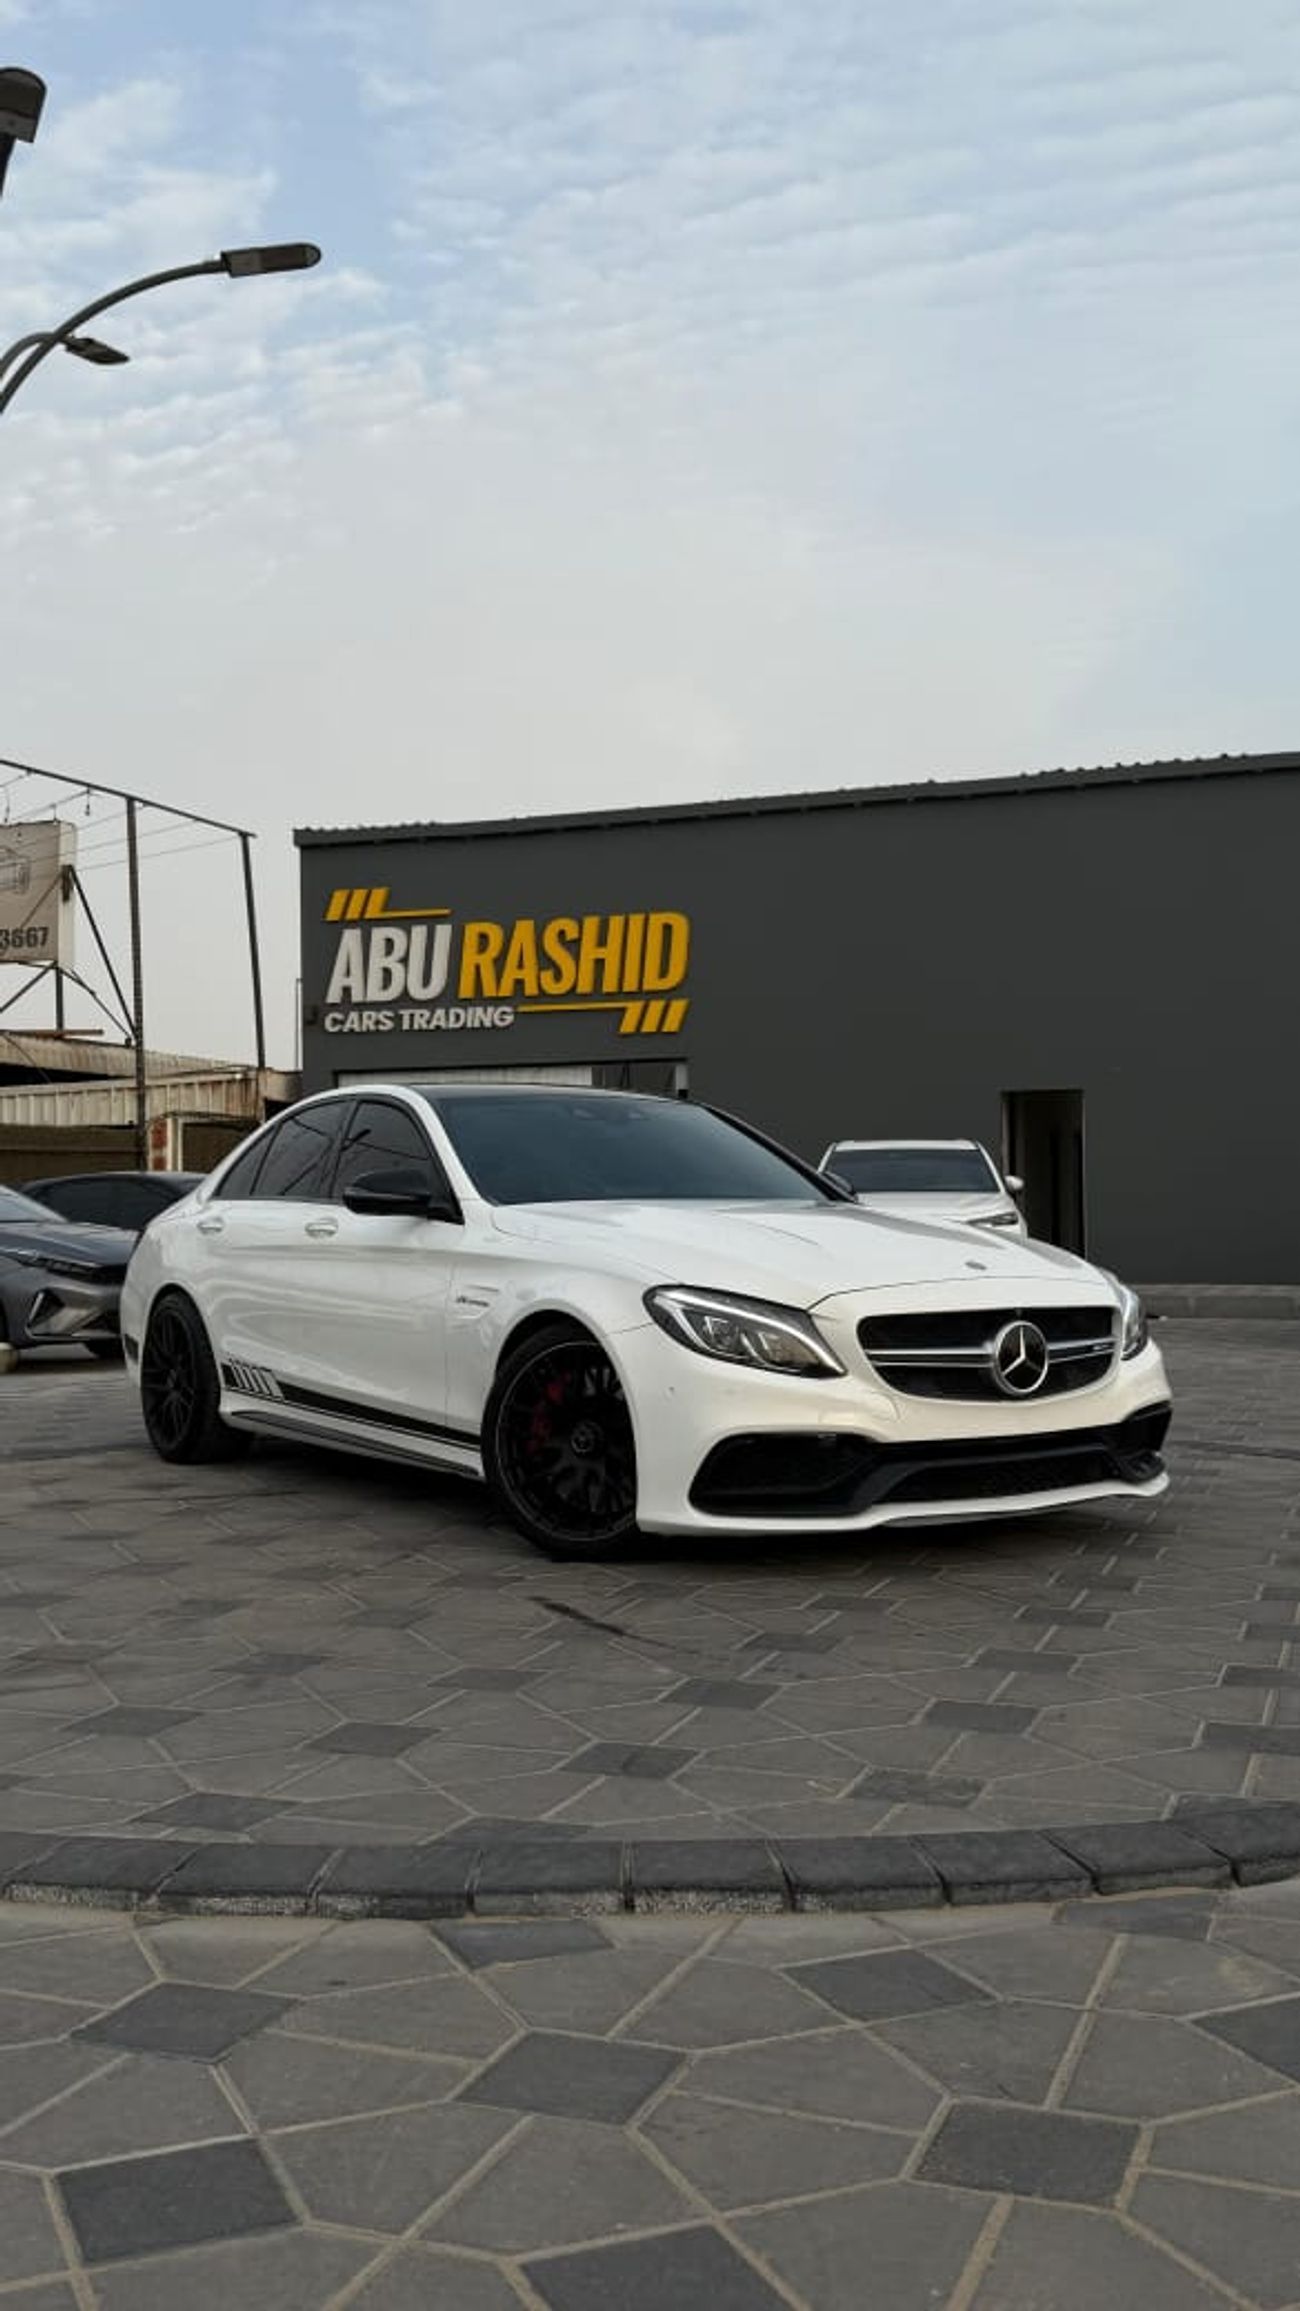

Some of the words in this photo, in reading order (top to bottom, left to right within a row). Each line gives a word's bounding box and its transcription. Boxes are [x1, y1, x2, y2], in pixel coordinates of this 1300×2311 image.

[326, 923, 453, 1003] ABU
[458, 912, 690, 999] RASHID
[324, 1010, 395, 1033] CARS
[399, 1005, 515, 1030] TRADING
